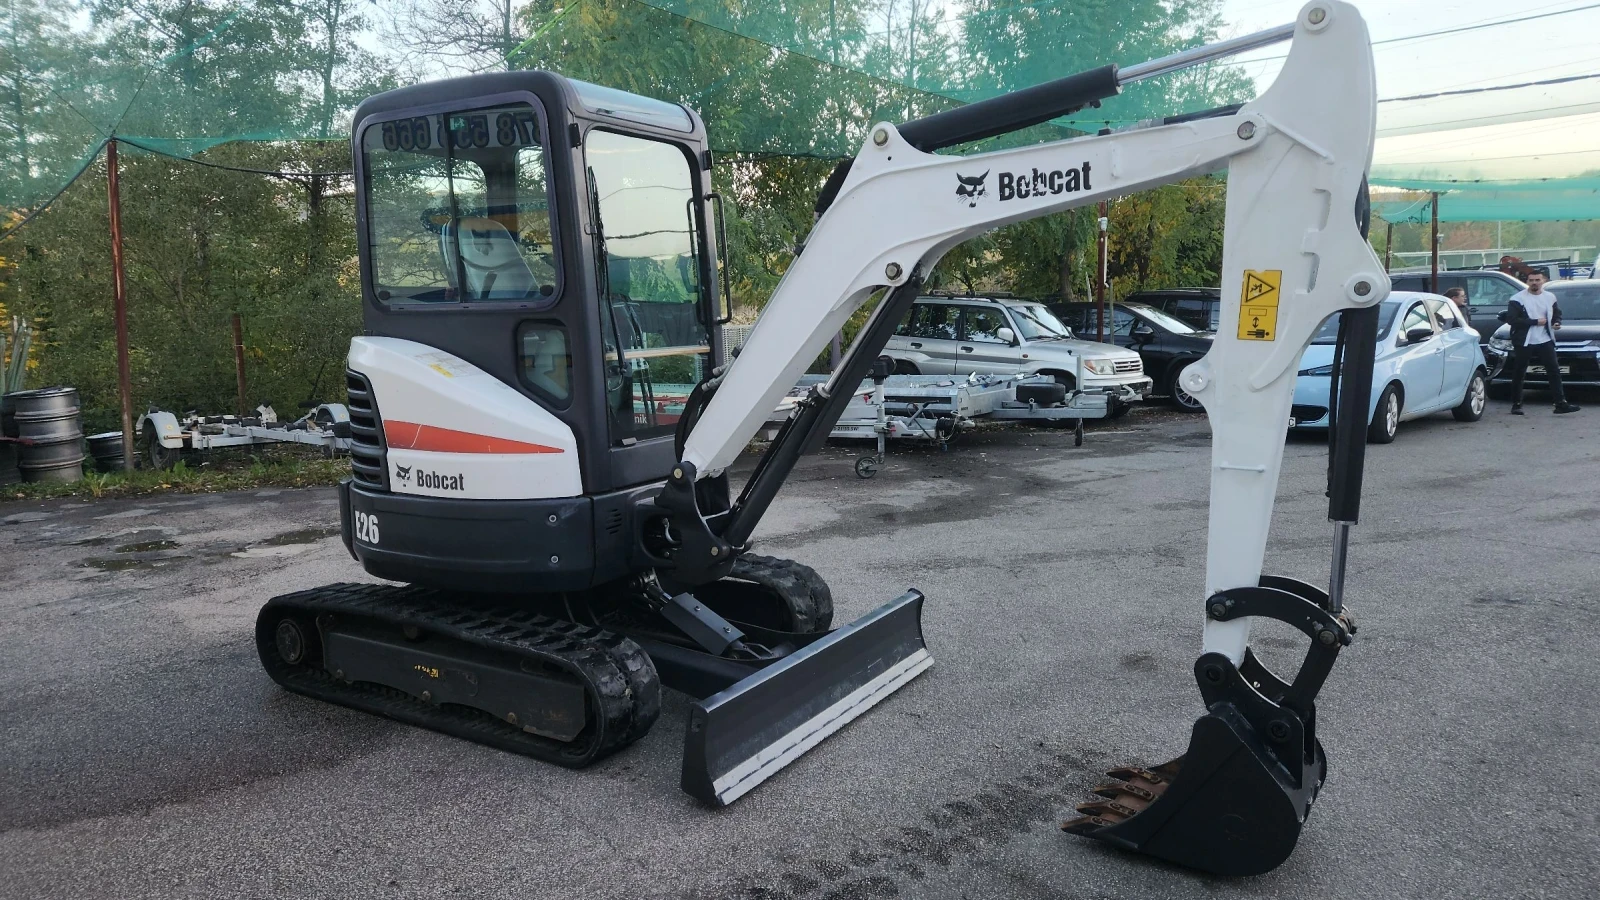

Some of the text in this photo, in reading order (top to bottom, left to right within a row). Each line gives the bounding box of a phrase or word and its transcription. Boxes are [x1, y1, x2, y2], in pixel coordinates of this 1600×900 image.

[999, 161, 1091, 201] Bobcat
[416, 469, 464, 491] Bobcat
[355, 510, 379, 544] E26
